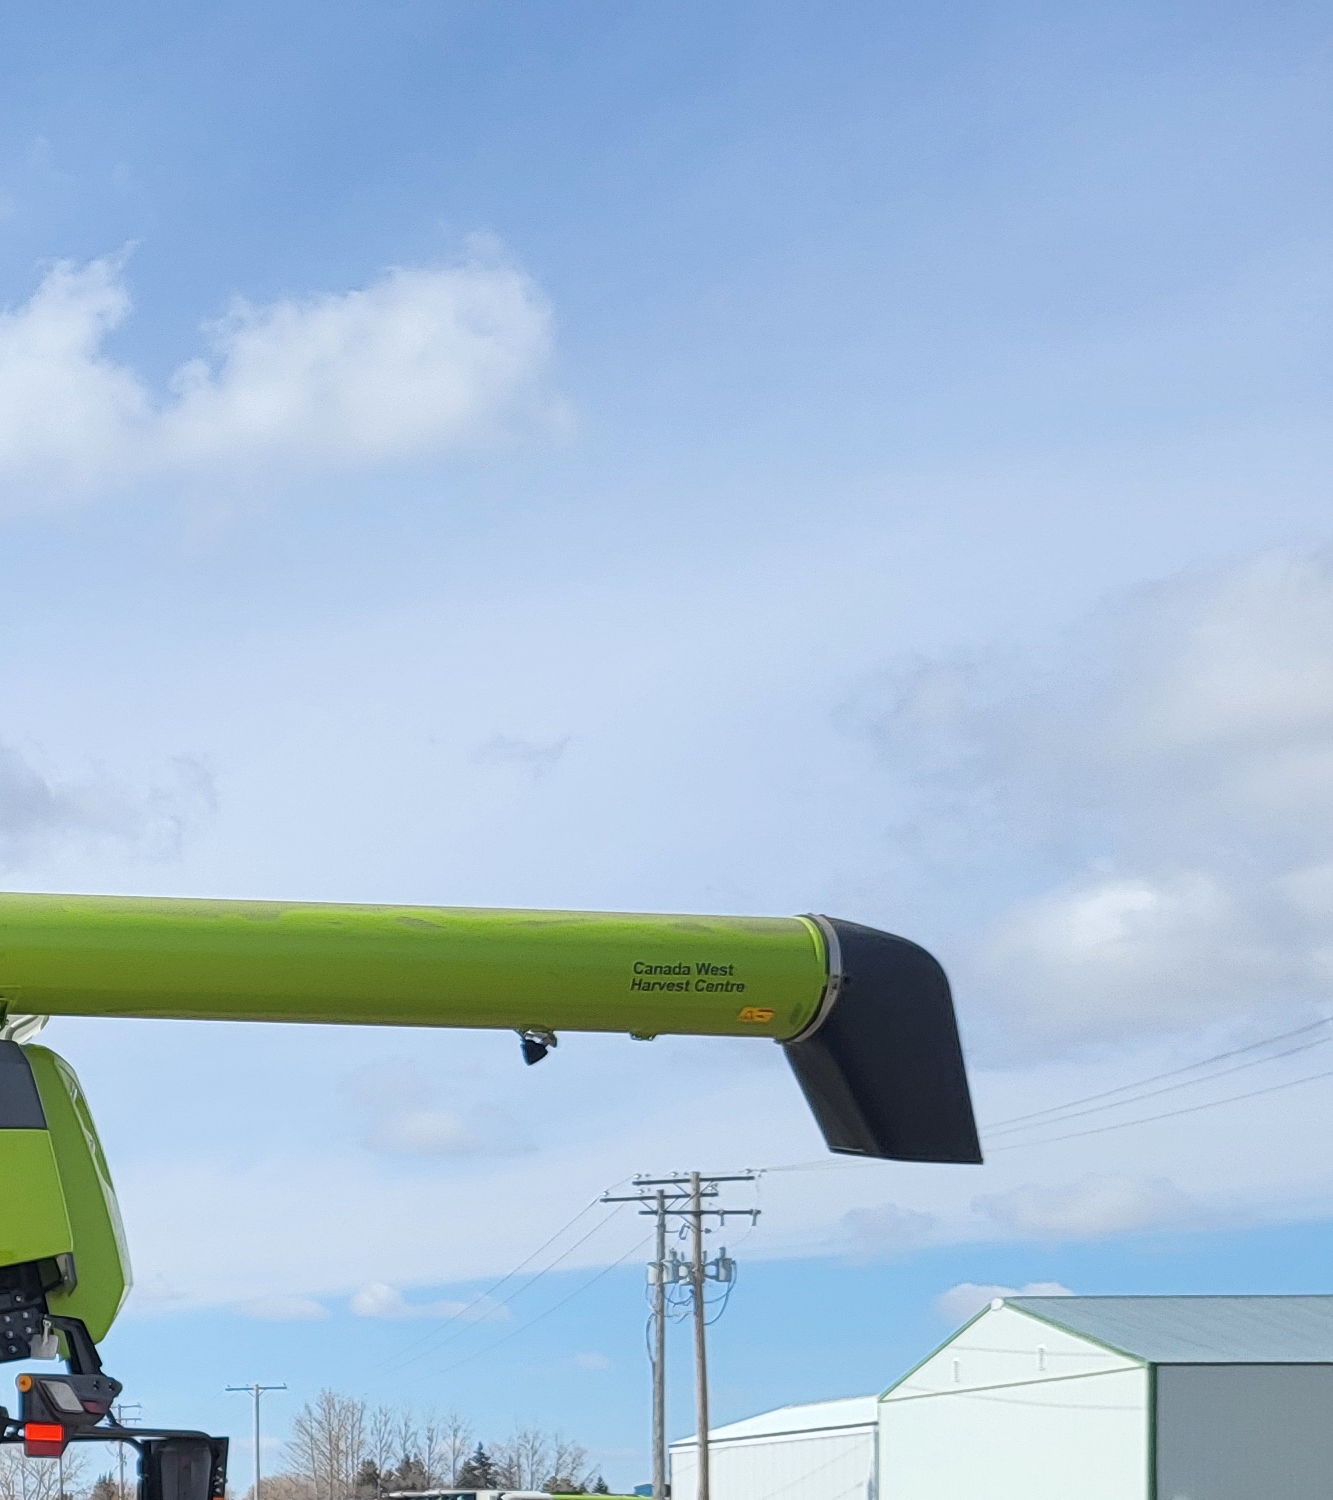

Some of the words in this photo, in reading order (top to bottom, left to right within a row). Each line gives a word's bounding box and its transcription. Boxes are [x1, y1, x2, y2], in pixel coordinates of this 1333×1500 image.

[633, 961, 691, 976] Canada
[695, 962, 735, 976] West
[630, 978, 690, 992] Harvest
[694, 979, 745, 993] Centre
